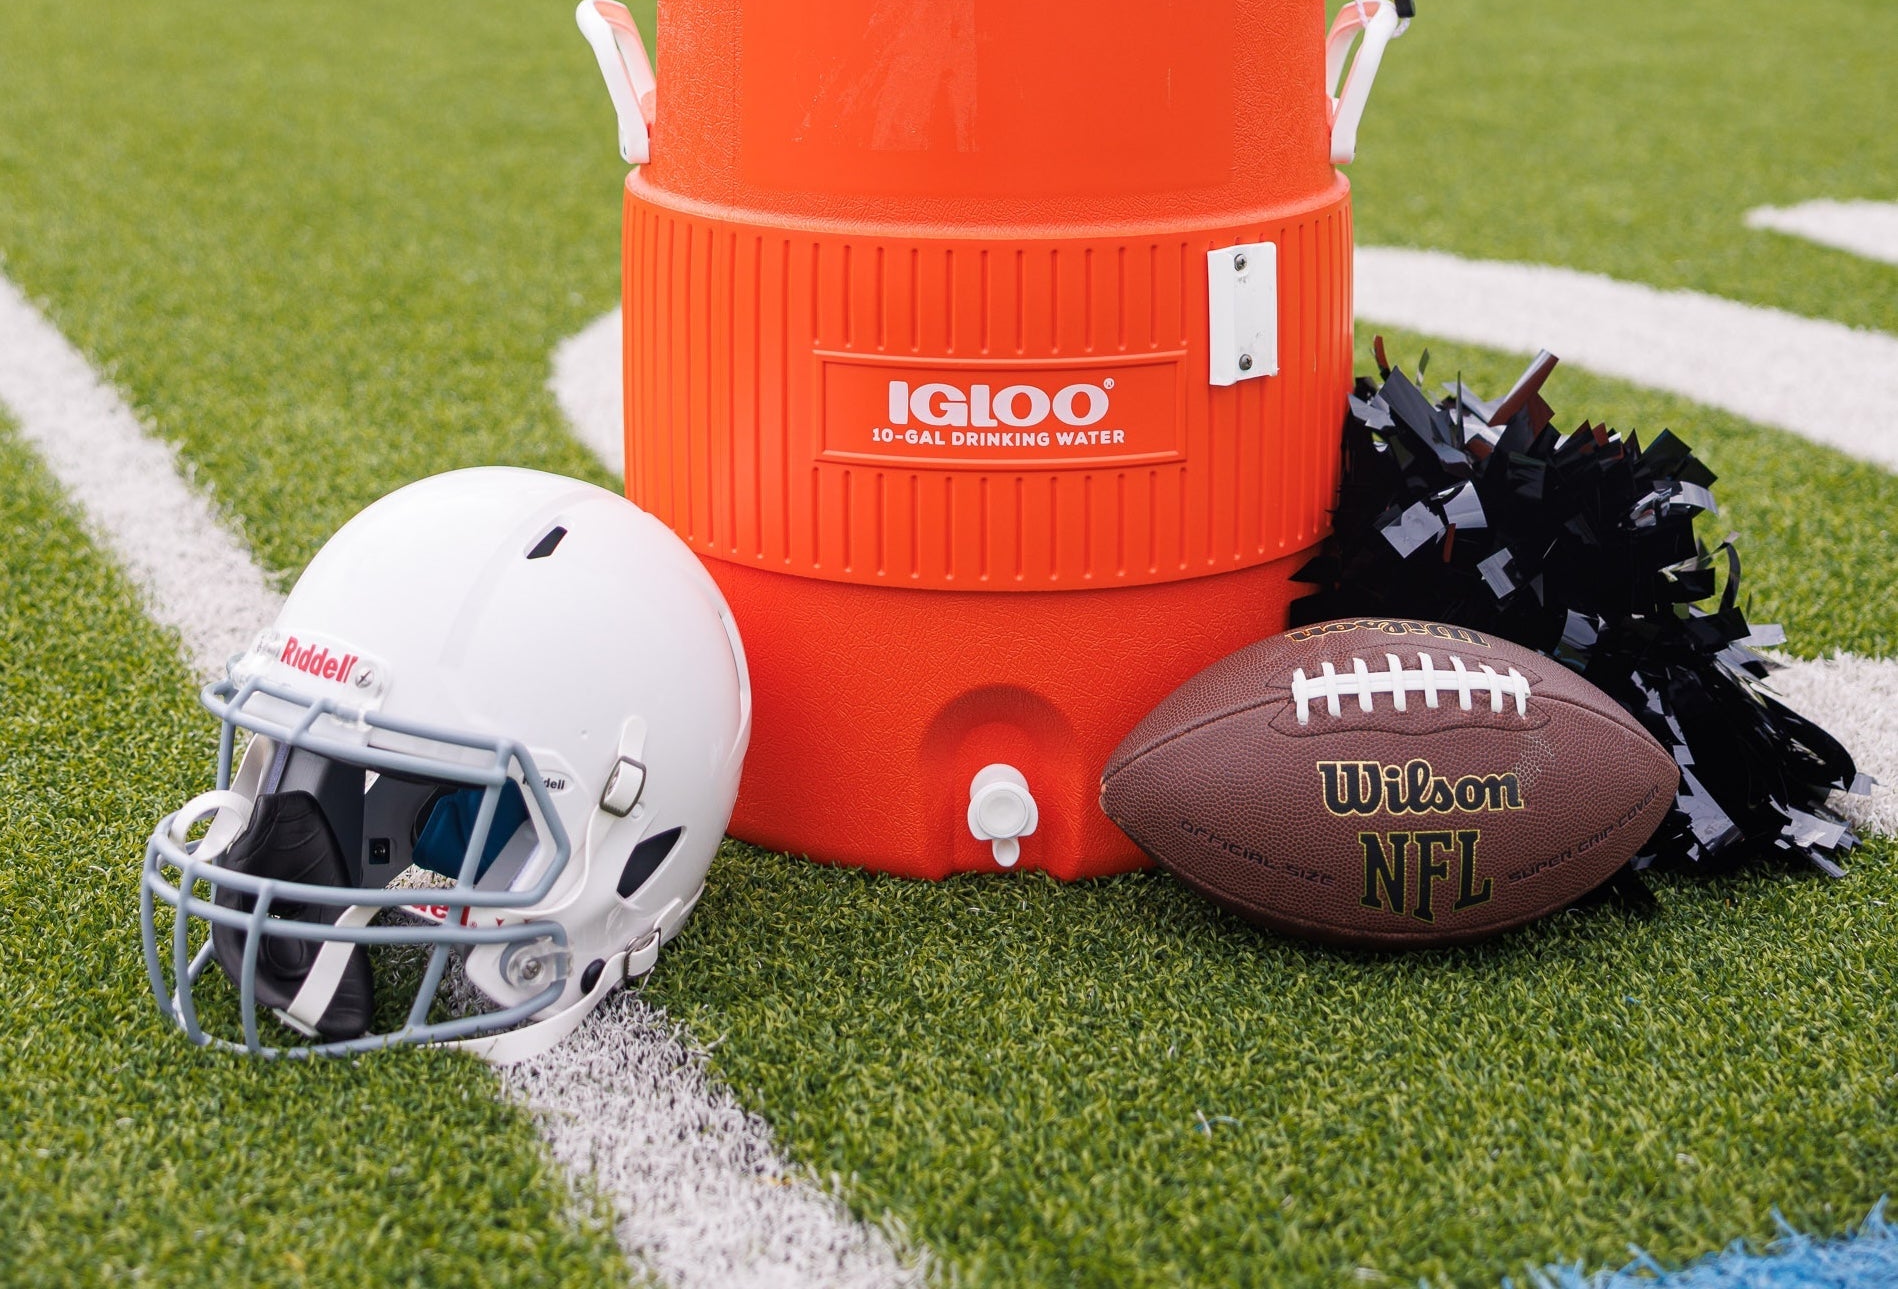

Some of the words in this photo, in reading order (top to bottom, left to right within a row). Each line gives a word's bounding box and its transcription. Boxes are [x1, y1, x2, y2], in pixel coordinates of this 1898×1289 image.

[888, 380, 1109, 427] IGLOO
[872, 427, 945, 446] 10-GAL
[951, 431, 1050, 447] DRINKING
[1055, 429, 1125, 446] WATER
[1285, 619, 1492, 649] Wilson
[280, 635, 359, 684] Riddell
[522, 774, 566, 791] dell
[1316, 758, 1525, 817] Wilson
[1181, 819, 1277, 870] OFFICIAL
[1286, 863, 1336, 887] SIZE
[1508, 846, 1573, 884] SUPER
[1576, 824, 1615, 855] GRIP
[1618, 783, 1661, 830] COVER
[1358, 828, 1494, 925] NFL
